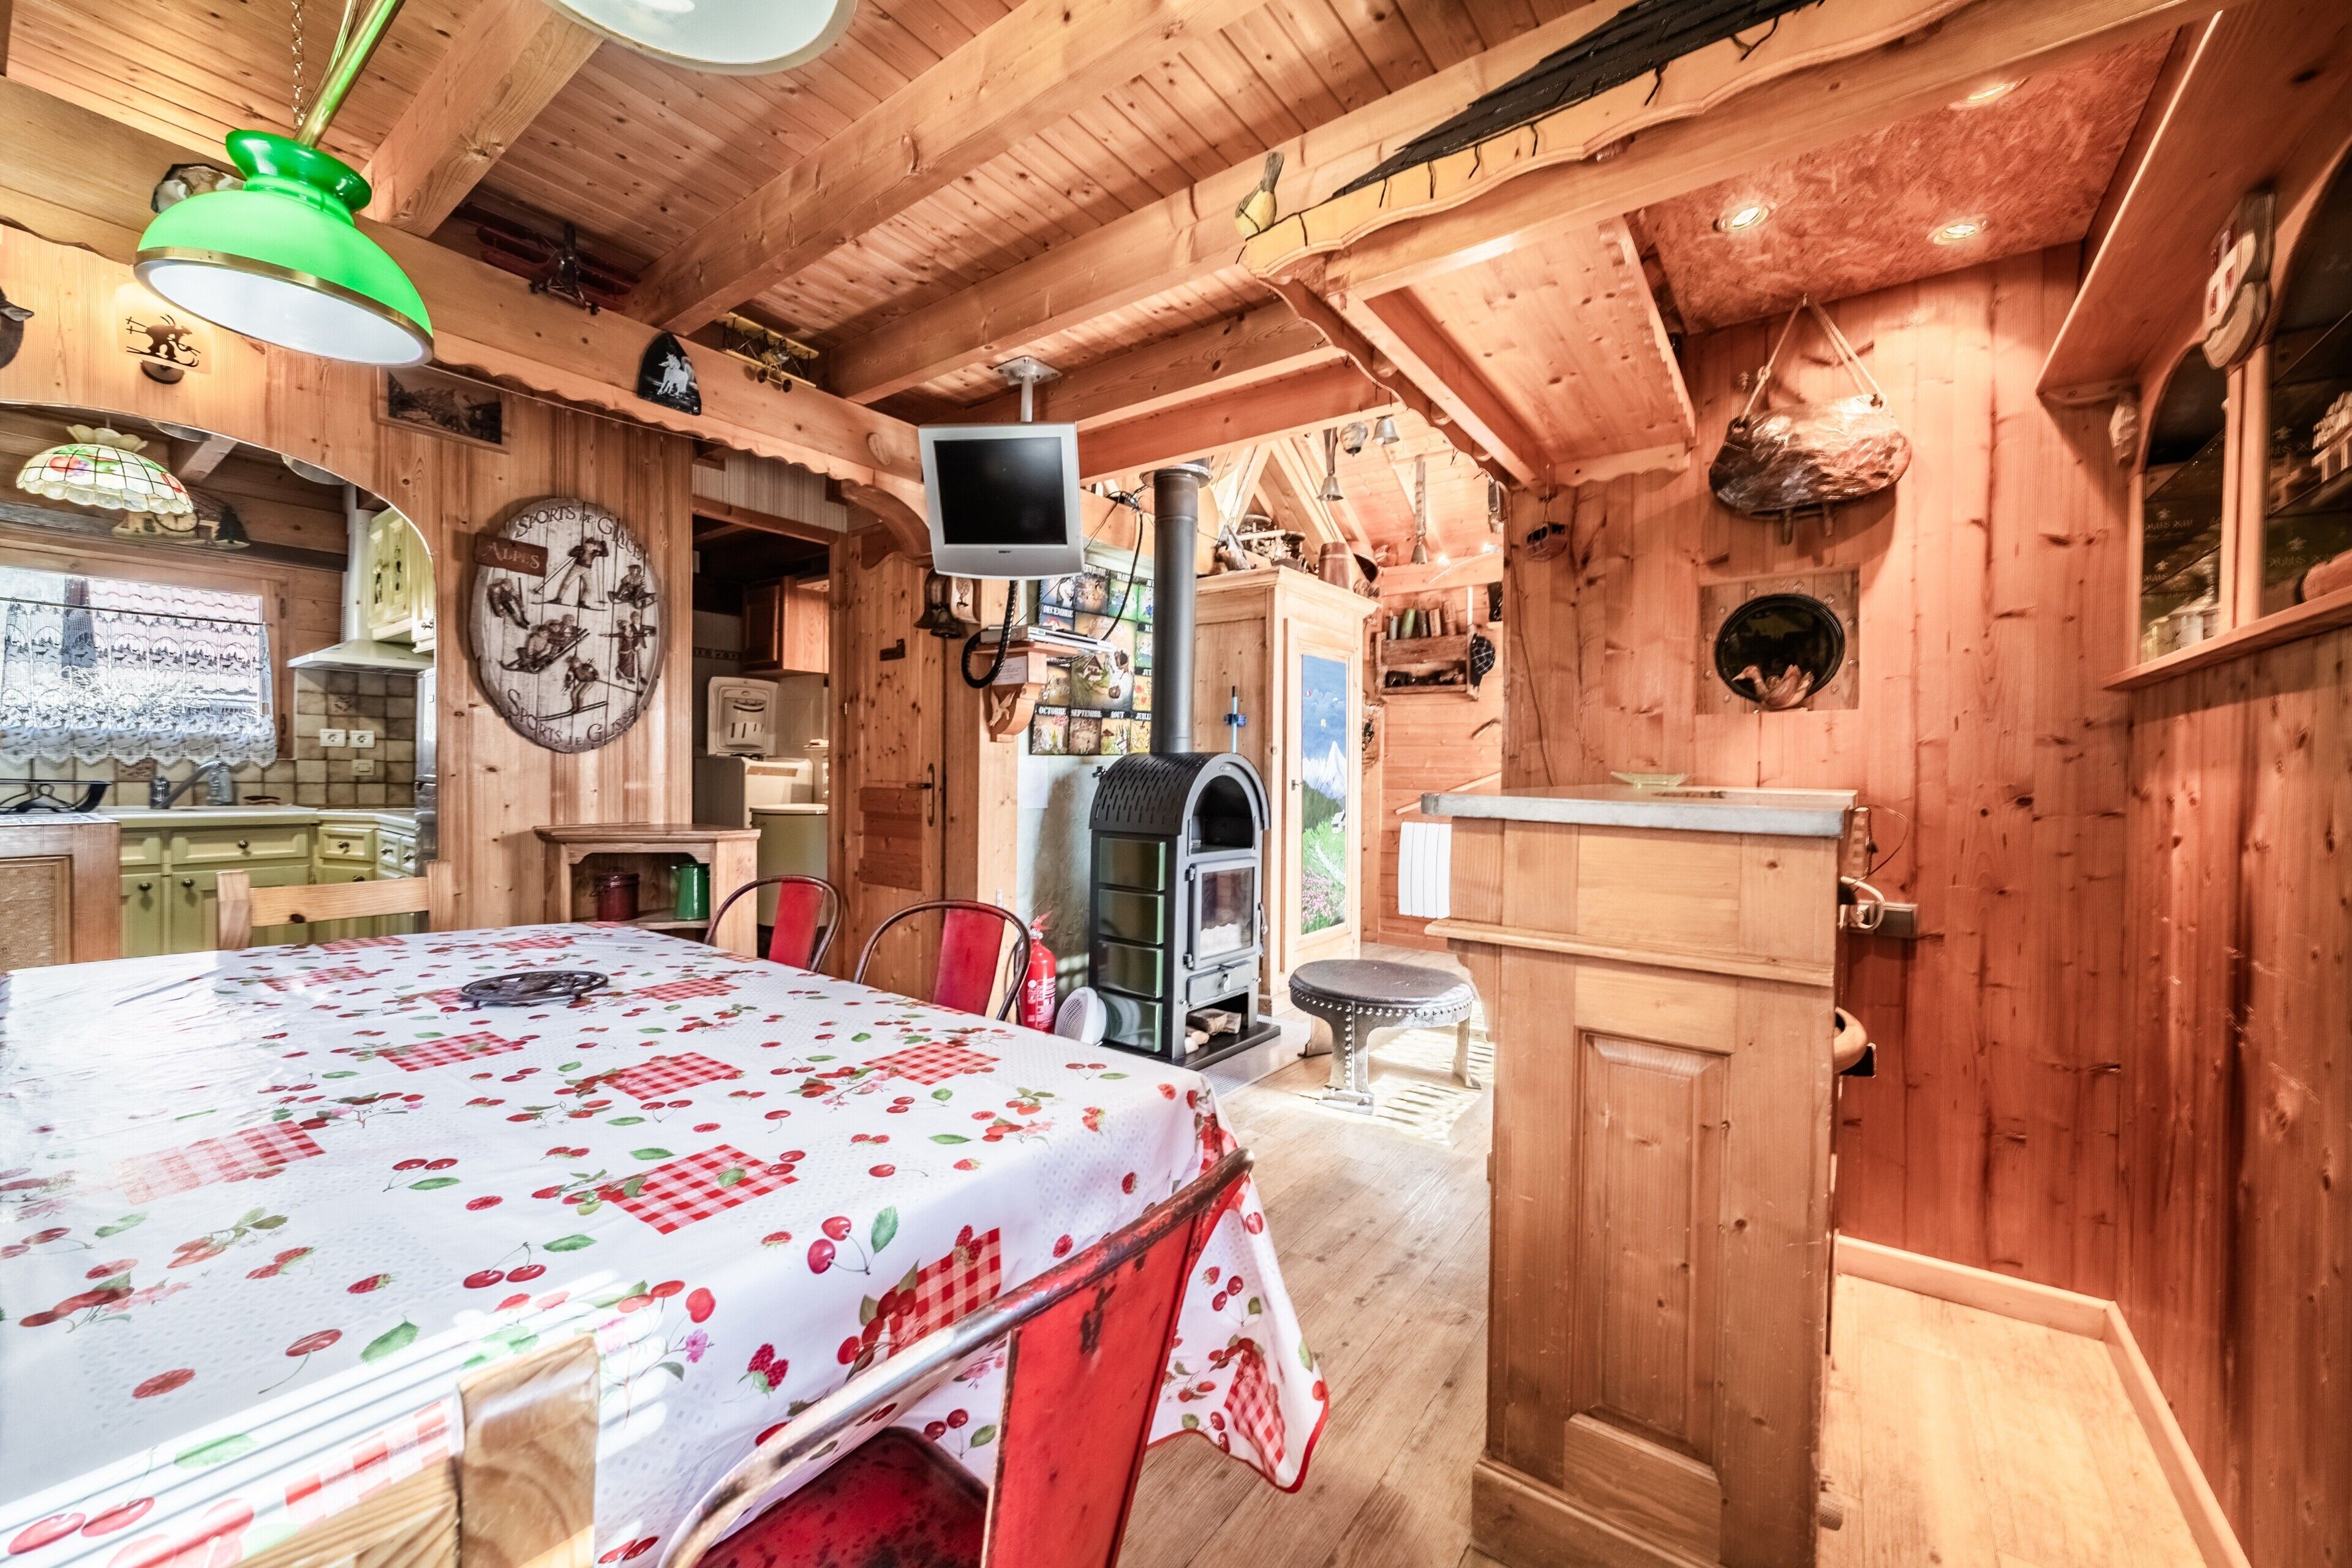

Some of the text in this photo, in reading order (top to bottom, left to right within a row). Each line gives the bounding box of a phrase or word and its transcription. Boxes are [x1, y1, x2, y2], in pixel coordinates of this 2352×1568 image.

[515, 506, 576, 539] SPORTS
[481, 541, 540, 569] ALPES
[1043, 605, 1074, 618] DECEMBRE
[508, 689, 563, 744] SPORTS
[1038, 706, 1067, 715] OCTOBRE
[1071, 709, 1102, 718] SEPTEMBRE
